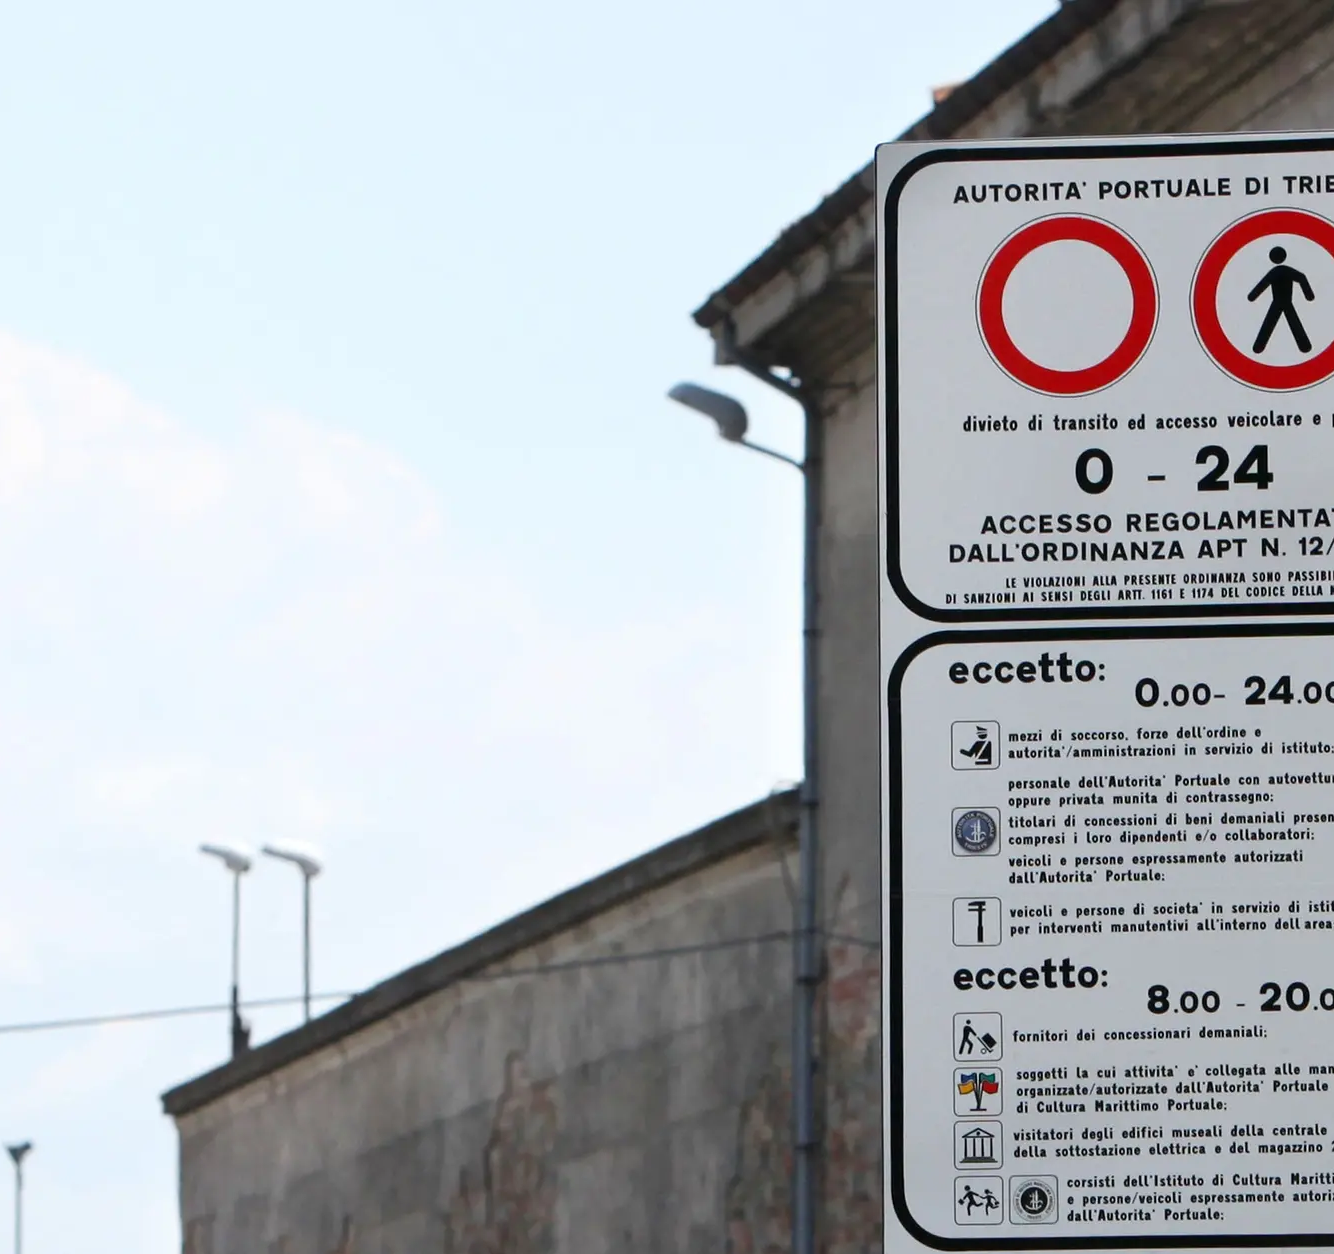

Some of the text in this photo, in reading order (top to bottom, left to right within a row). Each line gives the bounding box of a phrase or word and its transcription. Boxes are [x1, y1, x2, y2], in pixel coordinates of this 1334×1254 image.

[953, 181, 1087, 204] AUTORITA'
[1098, 177, 1232, 200] PORTUALE
[1245, 176, 1269, 196] DI
[962, 415, 1018, 432] divieto
[1027, 413, 1043, 432] di
[1052, 412, 1118, 431] transito
[1127, 413, 1146, 431] ed
[1155, 416, 1218, 430] accesso
[1227, 409, 1303, 428] veicolare
[1312, 413, 1322, 426] e
[1075, 447, 1114, 495] 0
[1195, 444, 1274, 492] 24
[980, 513, 1112, 535] ACCESSO
[949, 540, 1185, 563] DALL'ORDINANZA
[1197, 538, 1248, 559] APT
[1261, 537, 1287, 557] N.
[1005, 577, 1017, 589] LE
[1023, 575, 1086, 588] VIOLAZIONI
[1092, 575, 1118, 587] ALLA
[1123, 573, 1177, 586] PRESENTE
[1183, 572, 1246, 585] ORDINANZA
[1252, 571, 1281, 583] SONO
[945, 593, 957, 605] DI
[963, 592, 1016, 604] SANZIONI
[1022, 591, 1034, 603] AI
[1040, 590, 1073, 602] SENSI
[1080, 589, 1111, 602] DEGLI
[1151, 588, 1173, 600] 1161
[1191, 587, 1214, 599] 1174
[1221, 586, 1240, 599] DEL
[1245, 585, 1285, 598] CODICE
[1291, 584, 1324, 597] DELLA
[948, 651, 1106, 685] eccetto:
[1008, 729, 1043, 743] mezzi
[1050, 728, 1062, 742] di
[1136, 727, 1169, 740] forze
[1184, 743, 1197, 756] in
[1204, 742, 1254, 756] servizio
[1260, 741, 1273, 755] di
[1008, 776, 1071, 792] personale
[1174, 773, 1231, 787] Portuale
[1238, 776, 1260, 786] con
[1008, 791, 1178, 809] oppure privata munita di
[1008, 815, 1056, 829] titolari
[1063, 814, 1076, 828] di
[1084, 813, 1157, 827] concessioni
[1165, 812, 1177, 826] di
[1185, 812, 1213, 825] beni
[1220, 811, 1285, 825] demaniali
[1008, 831, 1065, 848] compresi
[1086, 831, 1112, 844] loro
[1119, 829, 1187, 845] dipendenti
[1008, 849, 1303, 868] veicoli persone espressamente autorizzati
[1009, 904, 1053, 918] veicoli
[1076, 906, 1125, 919] persone
[1132, 902, 1145, 916] di
[1211, 901, 1223, 914] in
[1231, 900, 1281, 914] servizio
[1288, 900, 1300, 913] di
[1010, 925, 1031, 938] per
[1038, 920, 1102, 935] interventi
[1110, 918, 1189, 933] manutentivi
[953, 957, 1108, 991] eccetto:
[1147, 984, 1221, 1015] 8.00
[1012, 1026, 1191, 1043] fornitori dei concessionari
[1016, 1066, 1068, 1082] soggetti
[1076, 1066, 1089, 1079] la
[1096, 1065, 1116, 1079] cui
[1205, 1063, 1266, 1079] collegata
[1274, 1062, 1301, 1076] alle
[1272, 1079, 1329, 1093] Portuale
[1016, 1099, 1159, 1114] di Cultura Marittimo
[1013, 1123, 1328, 1142] visitatori degli edifici museali della centrale
[1013, 1140, 1323, 1158] della sottostazione elettrica del magazzino
[1066, 1175, 1115, 1188] corsisti
[1211, 1173, 1224, 1187] di
[1232, 1173, 1282, 1186] Cultura
[1190, 1190, 1285, 1206] espressamente
